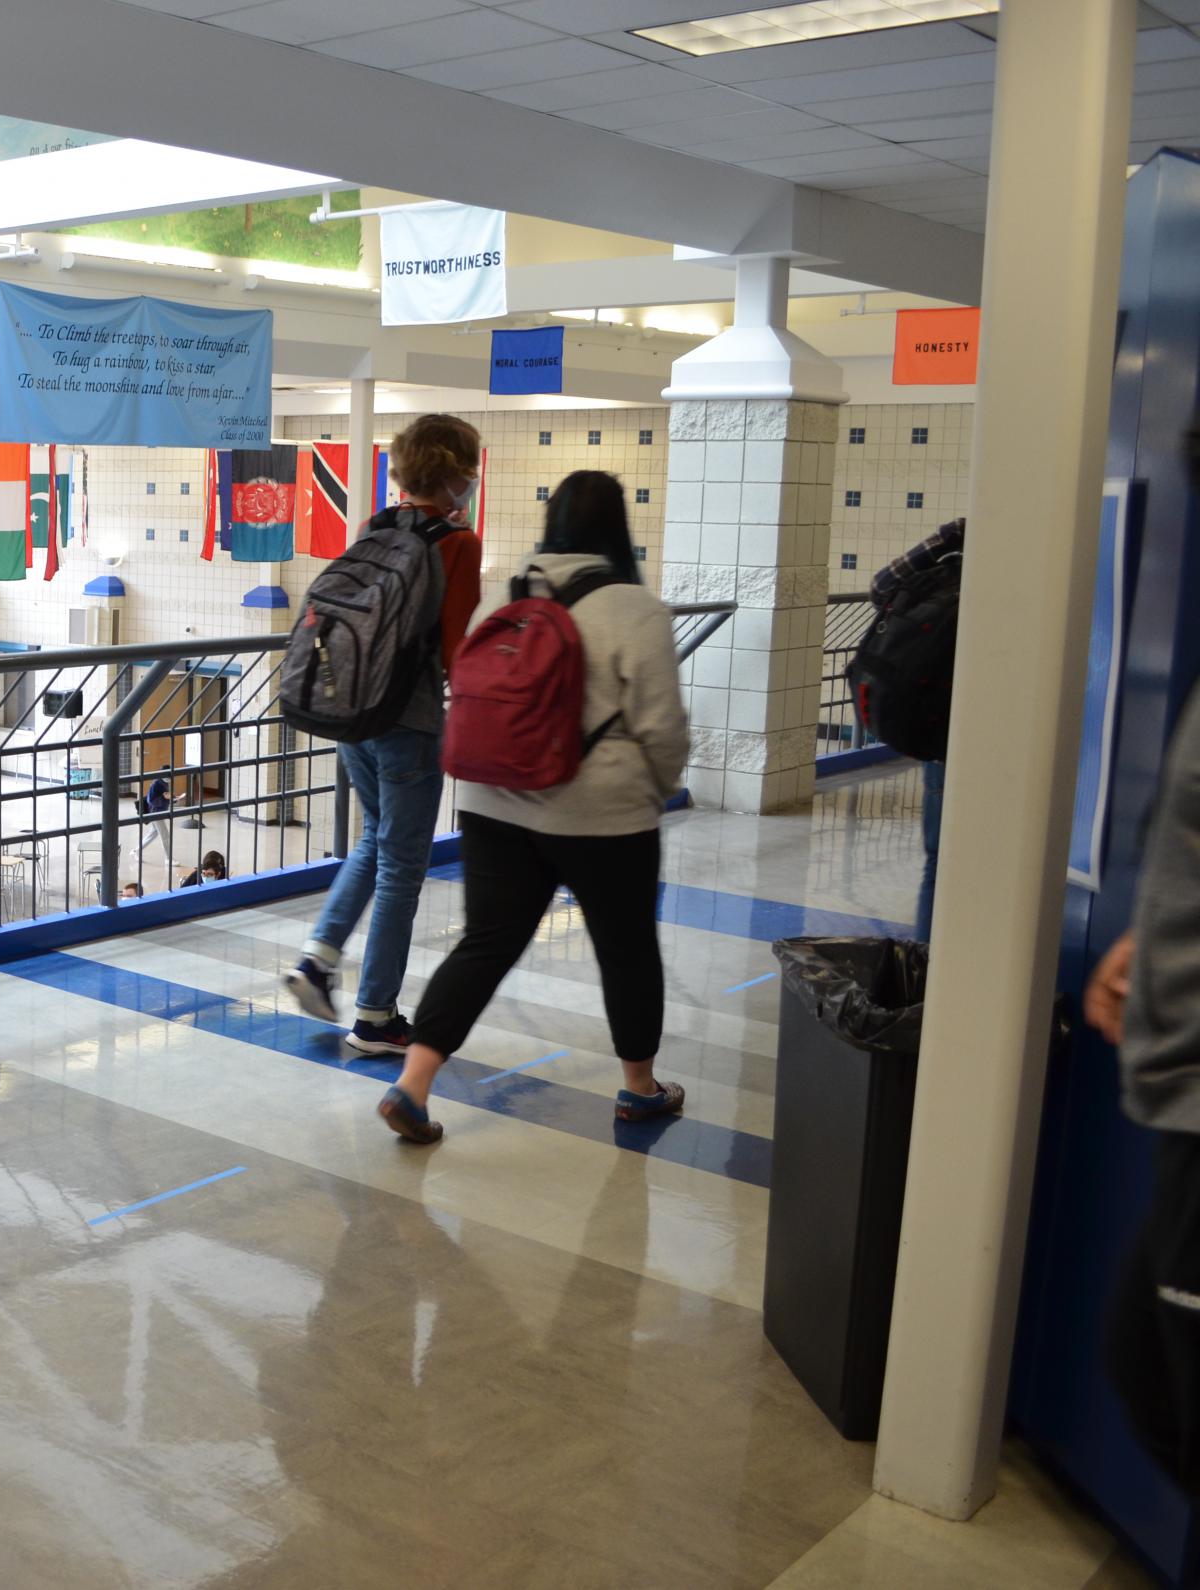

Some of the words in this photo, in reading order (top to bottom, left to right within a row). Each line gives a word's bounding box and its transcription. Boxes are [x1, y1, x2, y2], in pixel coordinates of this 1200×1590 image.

[385, 251, 501, 277] TRUSTWORTHINESS
[38, 323, 54, 339] To
[57, 324, 92, 342] Climb
[94, 326, 110, 343] the
[111, 330, 158, 351] treetops,
[160, 334, 169, 347] to
[170, 338, 194, 350] soar
[196, 335, 236, 358] through
[234, 340, 250, 356] air,
[915, 342, 969, 353] HONESTY
[52, 350, 67, 366] To
[69, 350, 92, 374] hug
[93, 357, 101, 368] a
[104, 353, 150, 372] rainbow,
[155, 358, 165, 370] to
[167, 355, 185, 376] kiss
[186, 364, 192, 373] a
[194, 362, 216, 376] star,
[495, 359, 519, 369] MORAL
[523, 356, 559, 368] COURAGE
[18, 373, 34, 389] To
[36, 374, 63, 391] steal
[64, 375, 81, 392] the
[85, 376, 139, 394] moonshine
[141, 380, 166, 395] and
[166, 379, 185, 396] love
[185, 381, 210, 403] from
[217, 415, 239, 428] Kevin
[220, 429, 238, 440] Class
[238, 429, 246, 444] of
[246, 431, 264, 441] 2000
